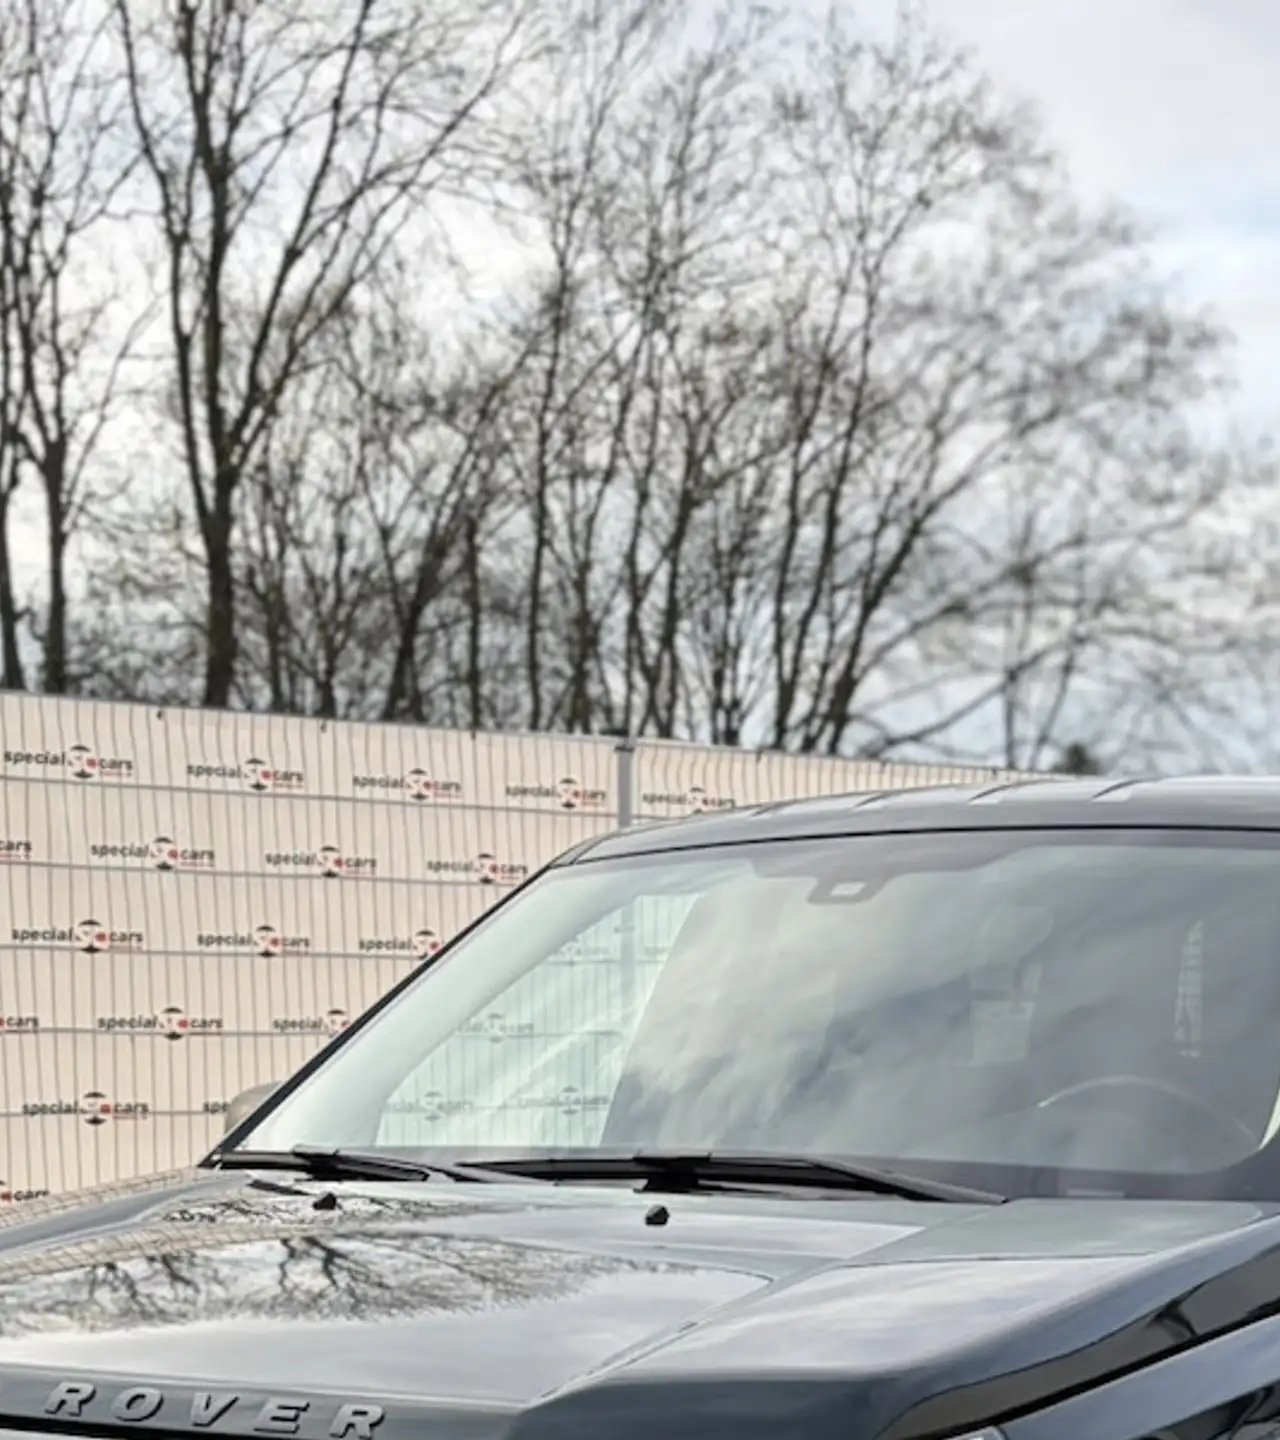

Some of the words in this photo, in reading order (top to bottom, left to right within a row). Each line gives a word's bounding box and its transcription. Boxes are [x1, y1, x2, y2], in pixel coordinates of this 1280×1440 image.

[3, 750, 66, 766] special
[97, 758, 133, 771] cars
[186, 764, 242, 779] special
[90, 844, 149, 858] special
[180, 849, 215, 861] cars
[265, 853, 317, 866] special
[11, 927, 74, 942] special
[108, 931, 144, 943] cars
[197, 933, 253, 947] special
[6, 1017, 40, 1028] cars
[98, 1016, 158, 1033] special
[190, 1018, 223, 1029] cars
[22, 1100, 80, 1117] special
[112, 1103, 150, 1115] cars
[44, 1381, 386, 1440] ROVER
